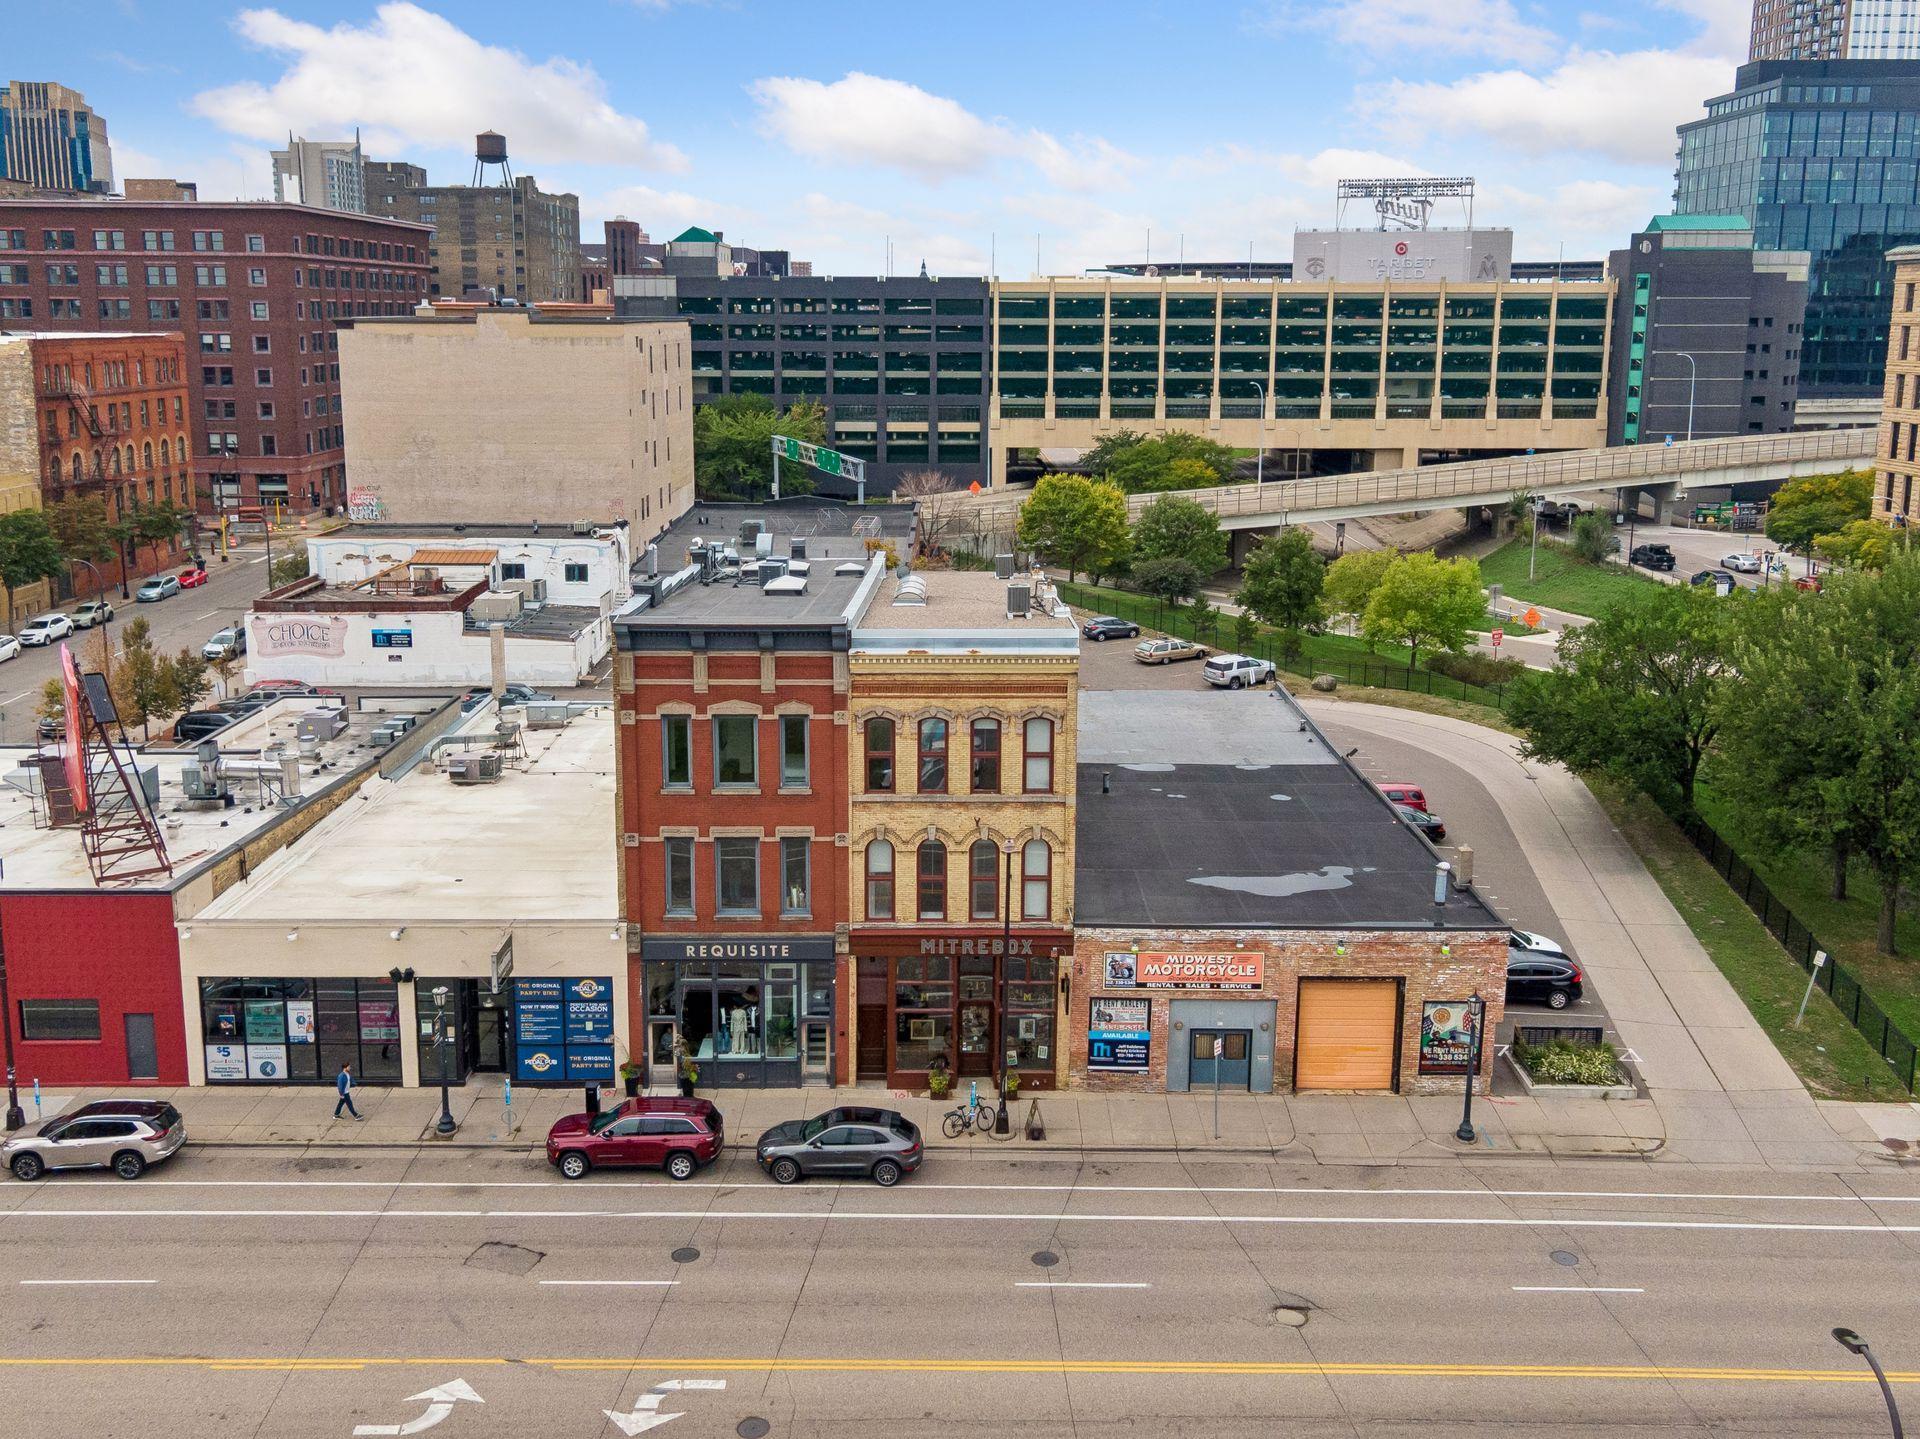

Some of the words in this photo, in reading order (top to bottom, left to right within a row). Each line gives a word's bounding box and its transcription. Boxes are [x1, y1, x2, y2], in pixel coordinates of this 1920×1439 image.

[1368, 257, 1435, 269] TARGET
[1375, 269, 1425, 280] FIELD
[268, 622, 330, 642] CHOICE
[686, 945, 789, 957] REQUISITE
[920, 939, 1033, 955] MITREBOX
[1166, 955, 1234, 964] MIDWEST
[1144, 964, 1256, 976] MOTORCYCLE
[967, 981, 987, 993] 213
[217, 1047, 230, 1057] $5
